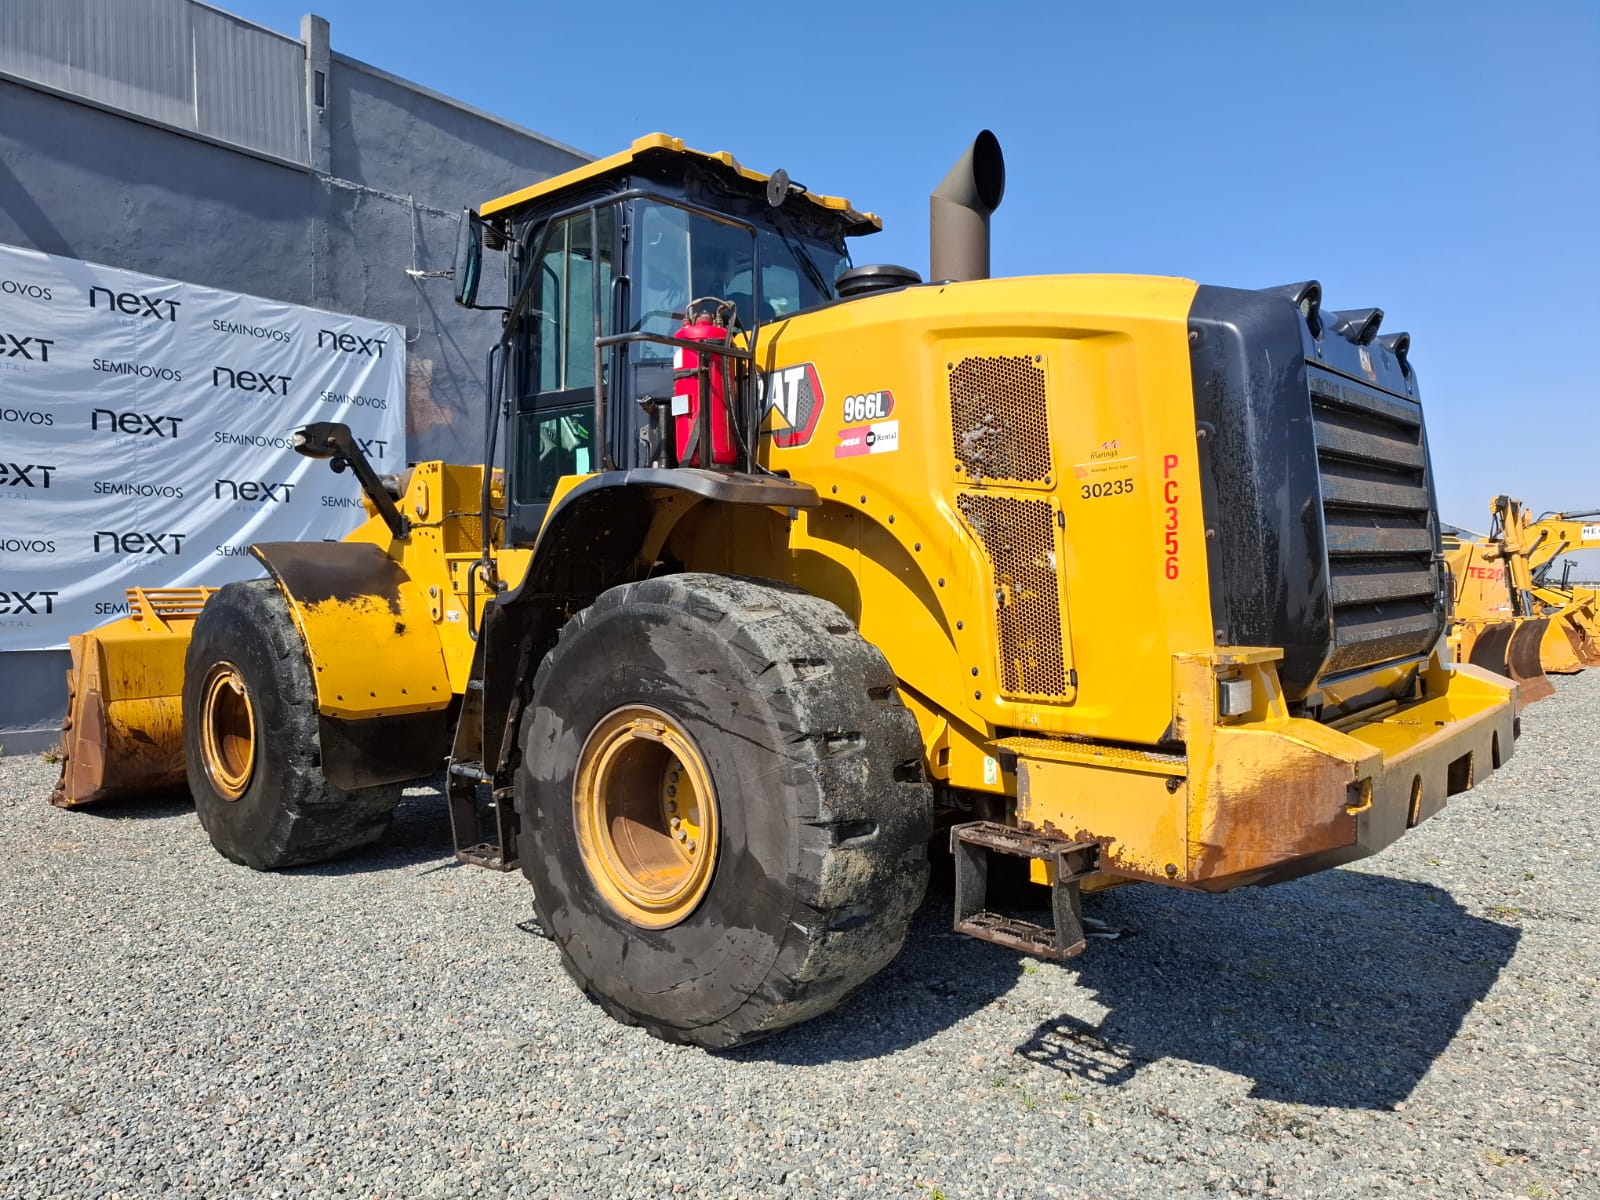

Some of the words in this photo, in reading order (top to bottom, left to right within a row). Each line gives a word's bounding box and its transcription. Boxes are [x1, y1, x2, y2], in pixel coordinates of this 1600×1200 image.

[212, 319, 291, 343] SEMINOVOS
[92, 358, 182, 382] SEMINOVOS
[320, 390, 387, 410] SEMINOVOS
[844, 392, 886, 422] 966L
[0, 408, 54, 426] OVOS
[214, 431, 293, 450] SEMINOVOS
[94, 481, 184, 499] SEMINOVOS
[1080, 478, 1135, 500] 30235
[1163, 454, 1180, 580] PC356
